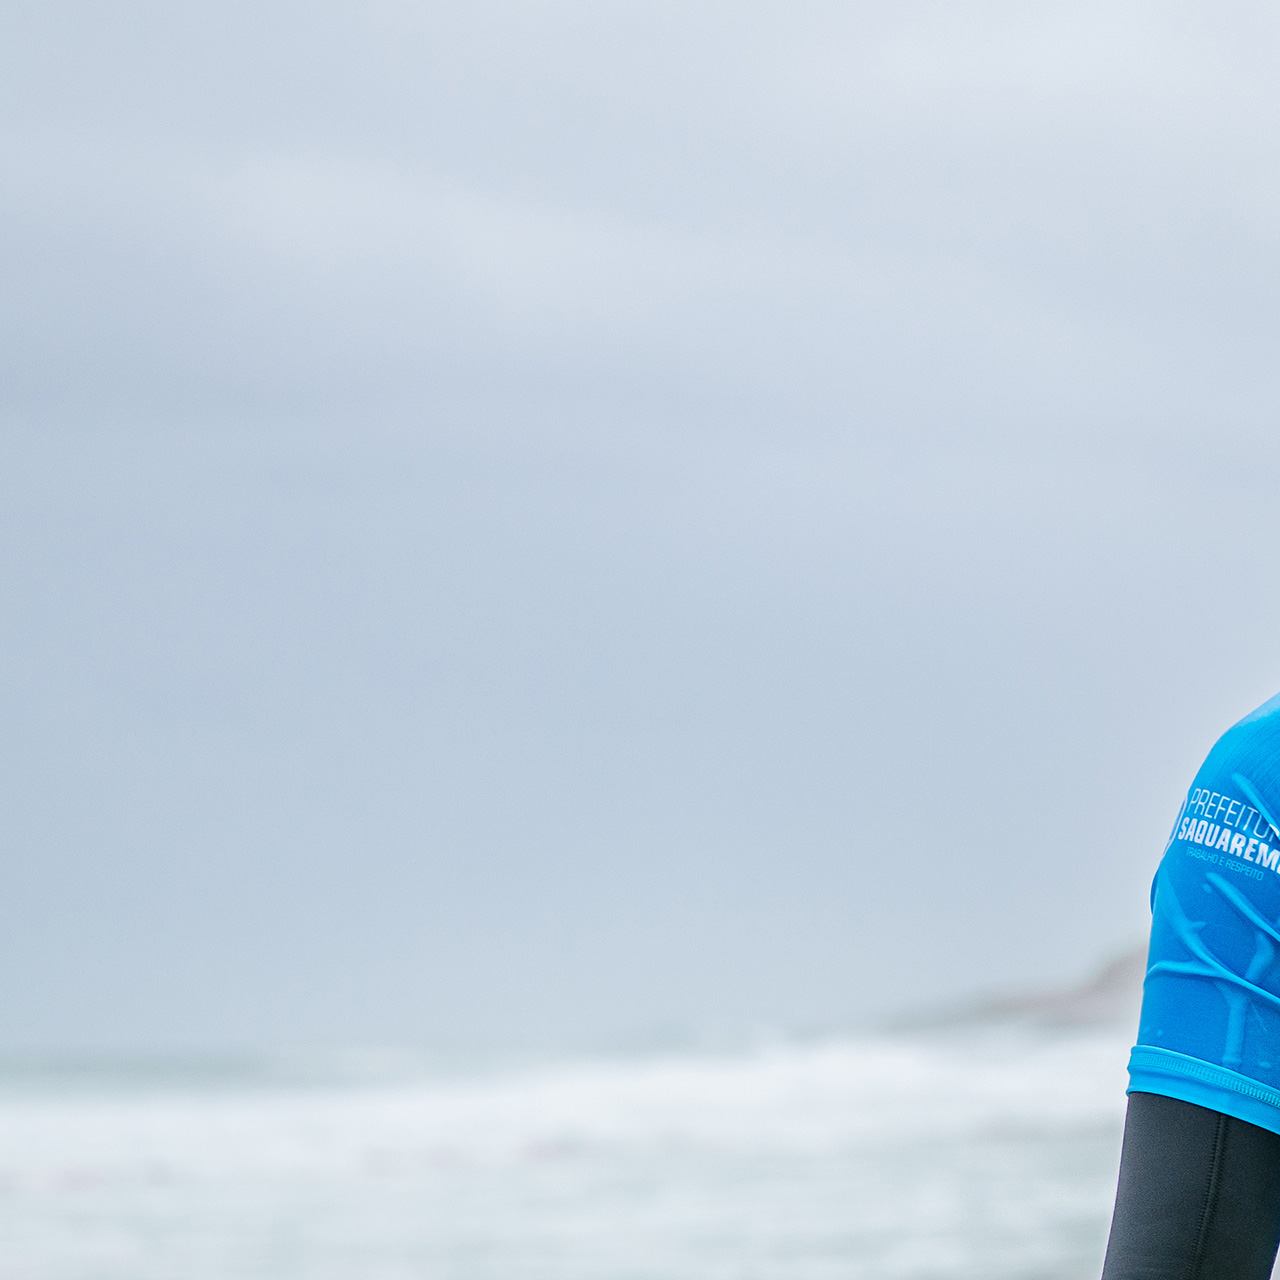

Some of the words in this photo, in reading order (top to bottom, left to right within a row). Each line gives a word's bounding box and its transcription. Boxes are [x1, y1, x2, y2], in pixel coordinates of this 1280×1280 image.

[1186, 846, 1218, 866] TRABALHO
[1219, 856, 1226, 867] E
[1226, 858, 1264, 881] RESPEITO
